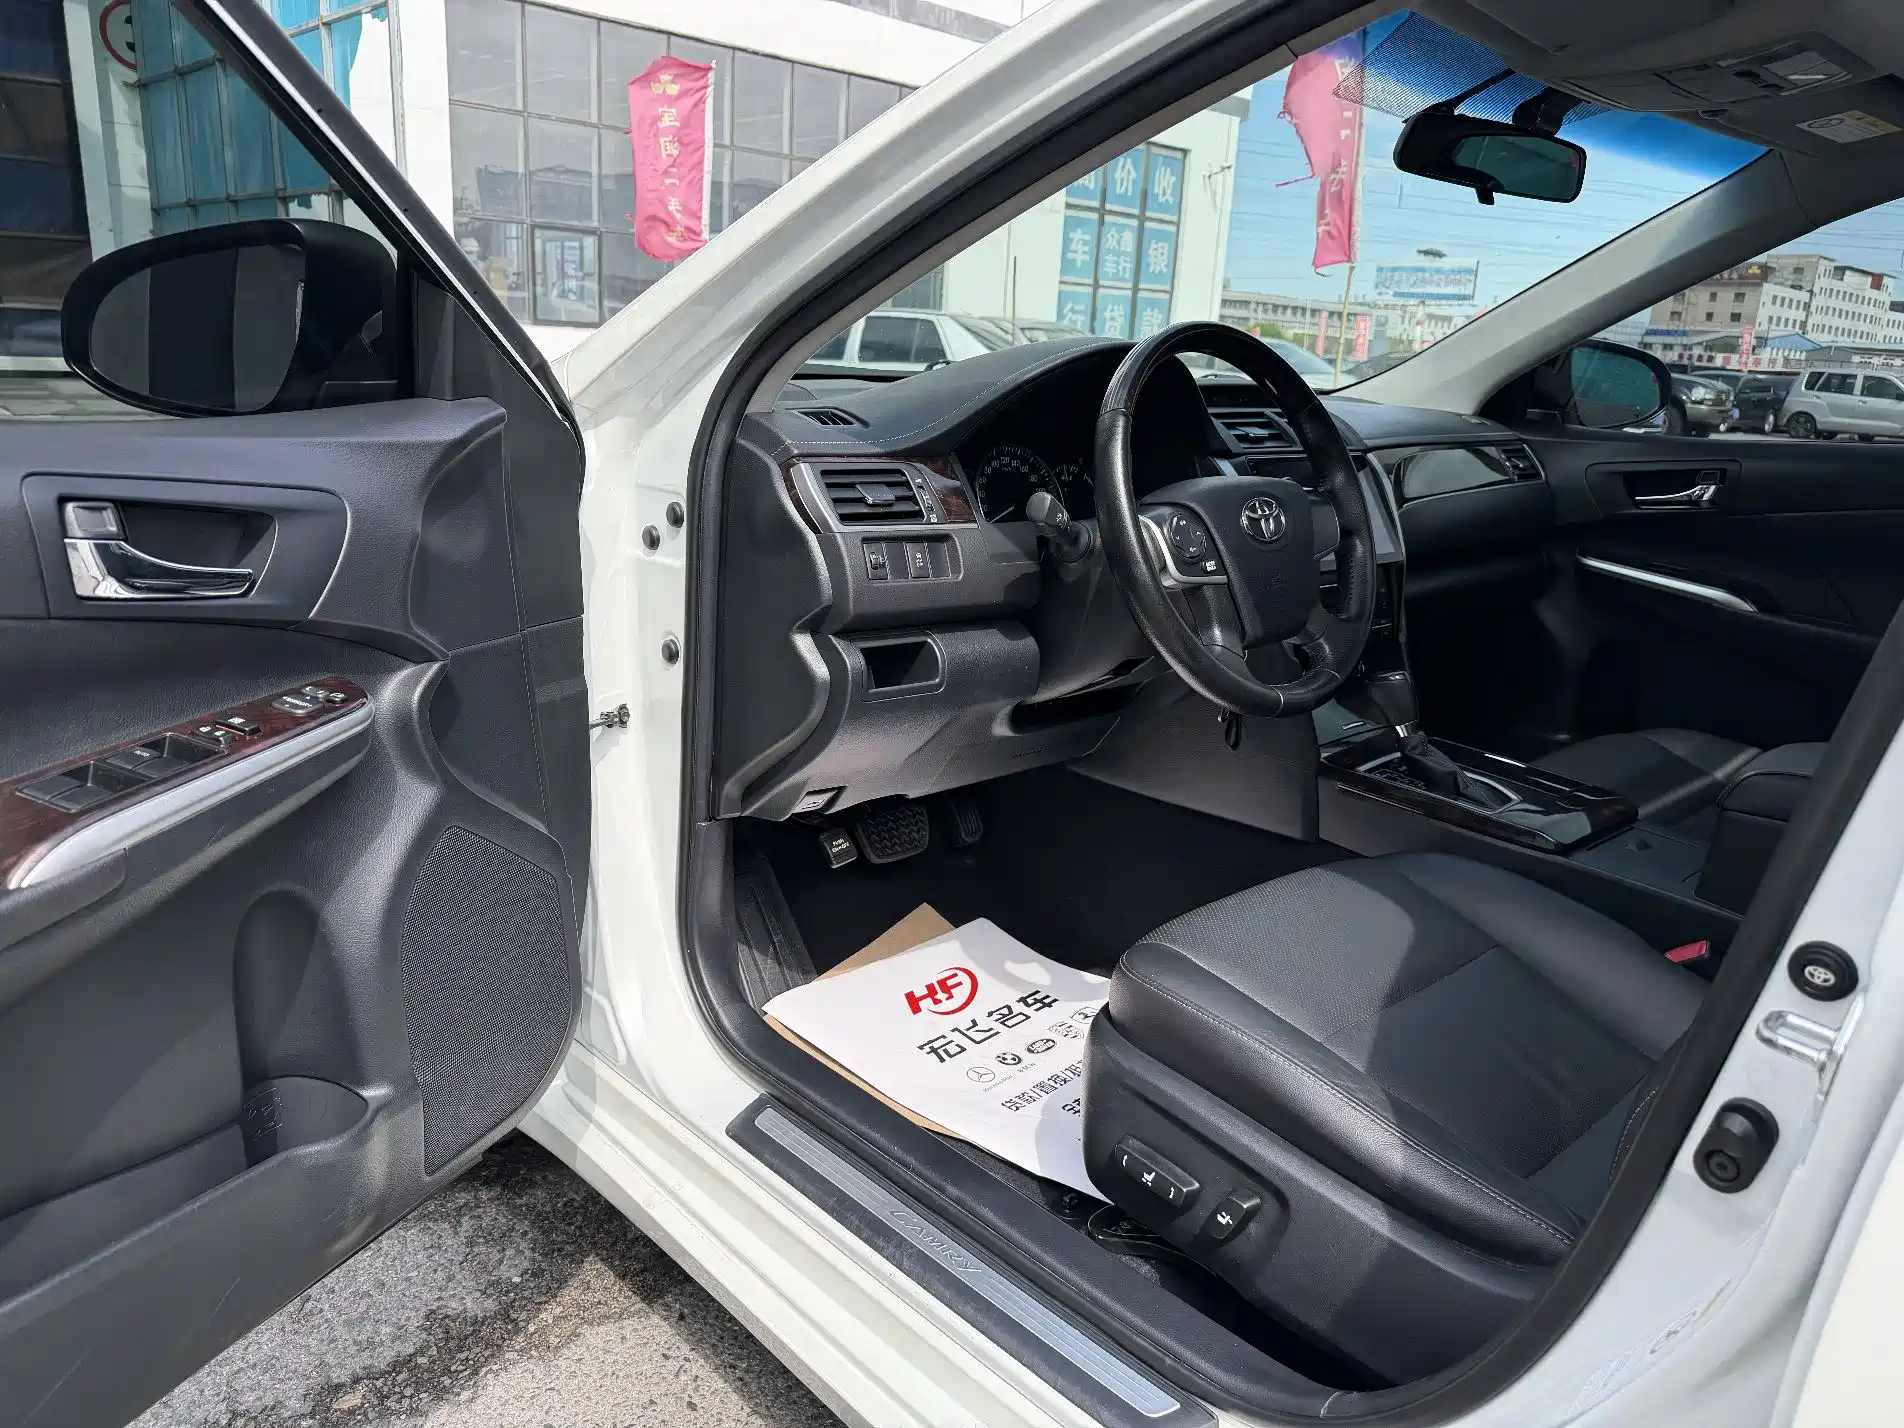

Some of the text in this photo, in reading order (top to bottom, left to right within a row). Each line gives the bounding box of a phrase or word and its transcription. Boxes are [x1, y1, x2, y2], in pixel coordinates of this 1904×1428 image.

[1066, 228, 1091, 268] 车
[1147, 240, 1169, 275] 银
[904, 971, 965, 1015] HF
[916, 990, 1059, 1064] 宏飞名车
